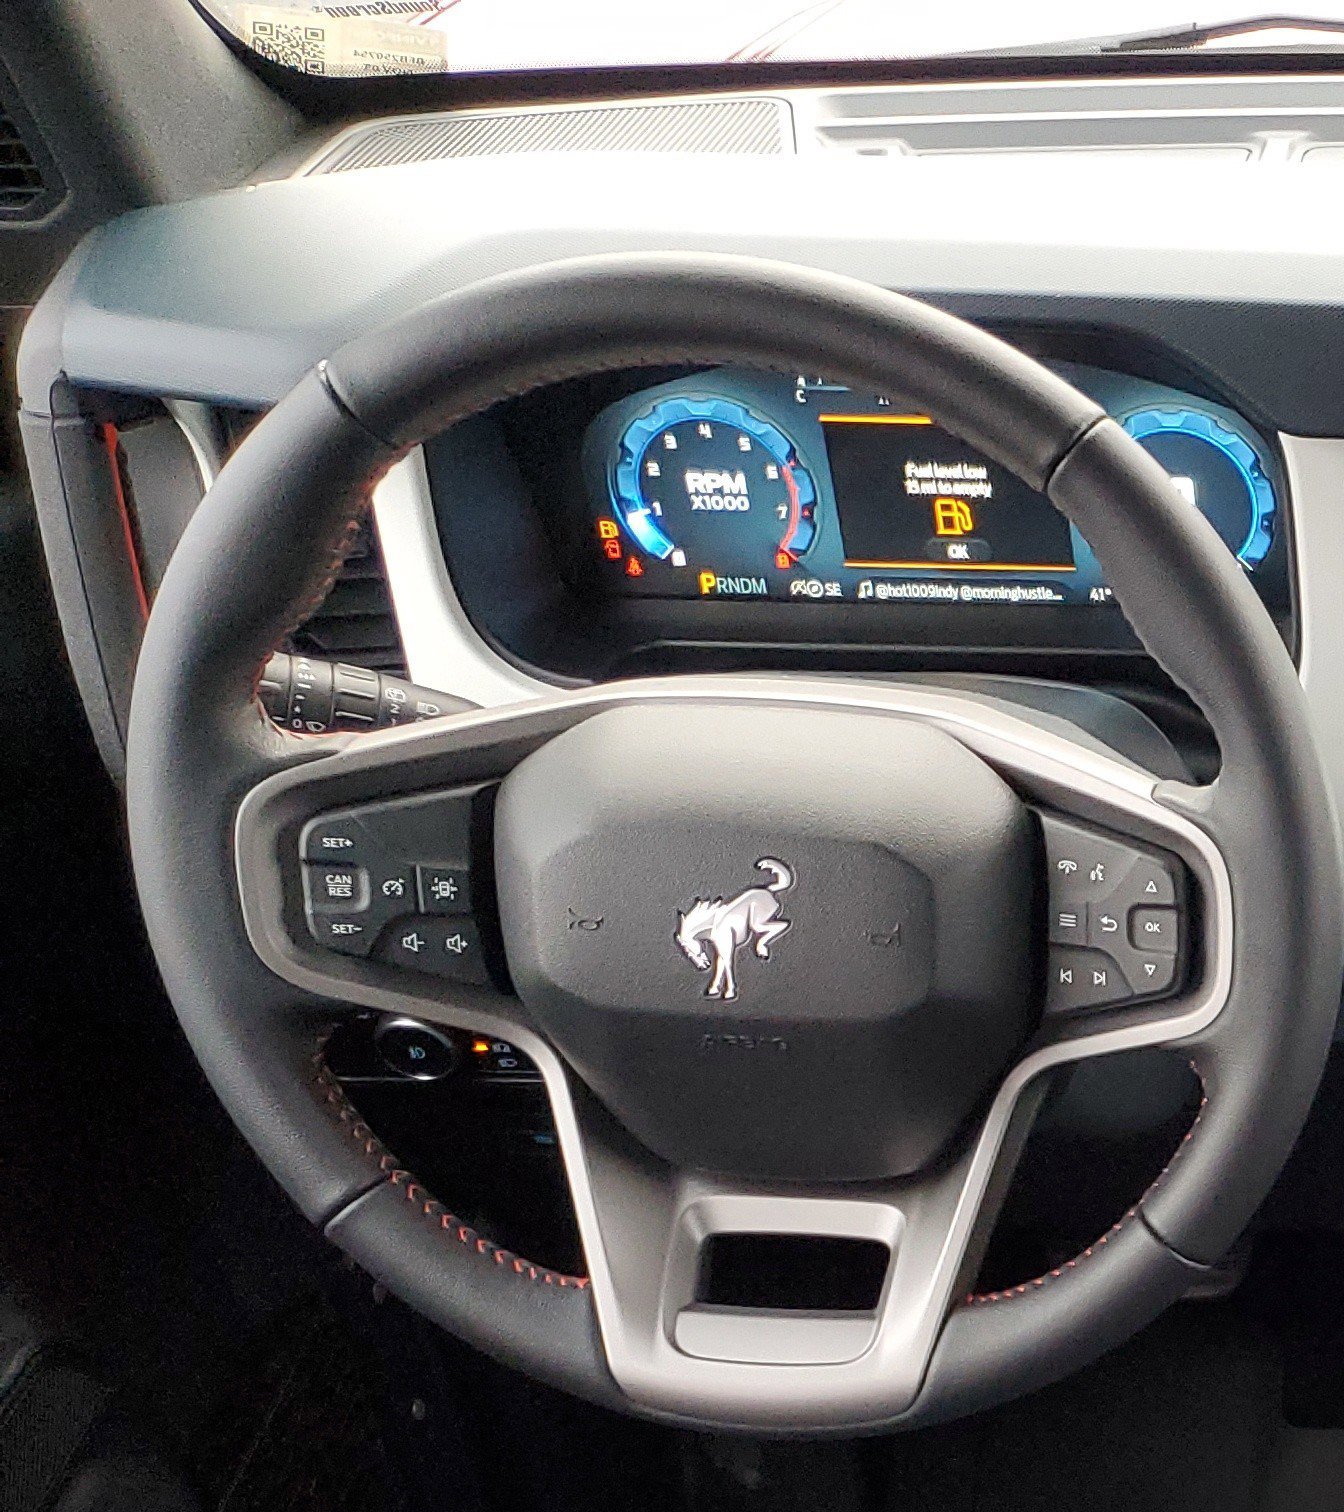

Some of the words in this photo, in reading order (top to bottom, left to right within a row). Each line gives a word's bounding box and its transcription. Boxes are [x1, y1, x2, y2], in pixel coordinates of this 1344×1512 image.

[698, 423, 712, 438] 4
[664, 432, 678, 450] 3
[738, 436, 751, 452] 5
[646, 461, 661, 477] 2
[766, 463, 778, 479] 6
[685, 469, 749, 495] RPM
[652, 501, 663, 516] 1
[691, 495, 749, 511] X1000
[776, 503, 788, 520] 7
[948, 544, 970, 559] OK
[700, 571, 767, 595] PRNDM
[825, 582, 843, 597] SE
[322, 837, 354, 848] SET+
[325, 875, 352, 885] CAN
[328, 887, 352, 897] RES
[331, 924, 363, 934] SET-
[1145, 922, 1161, 933] OK
